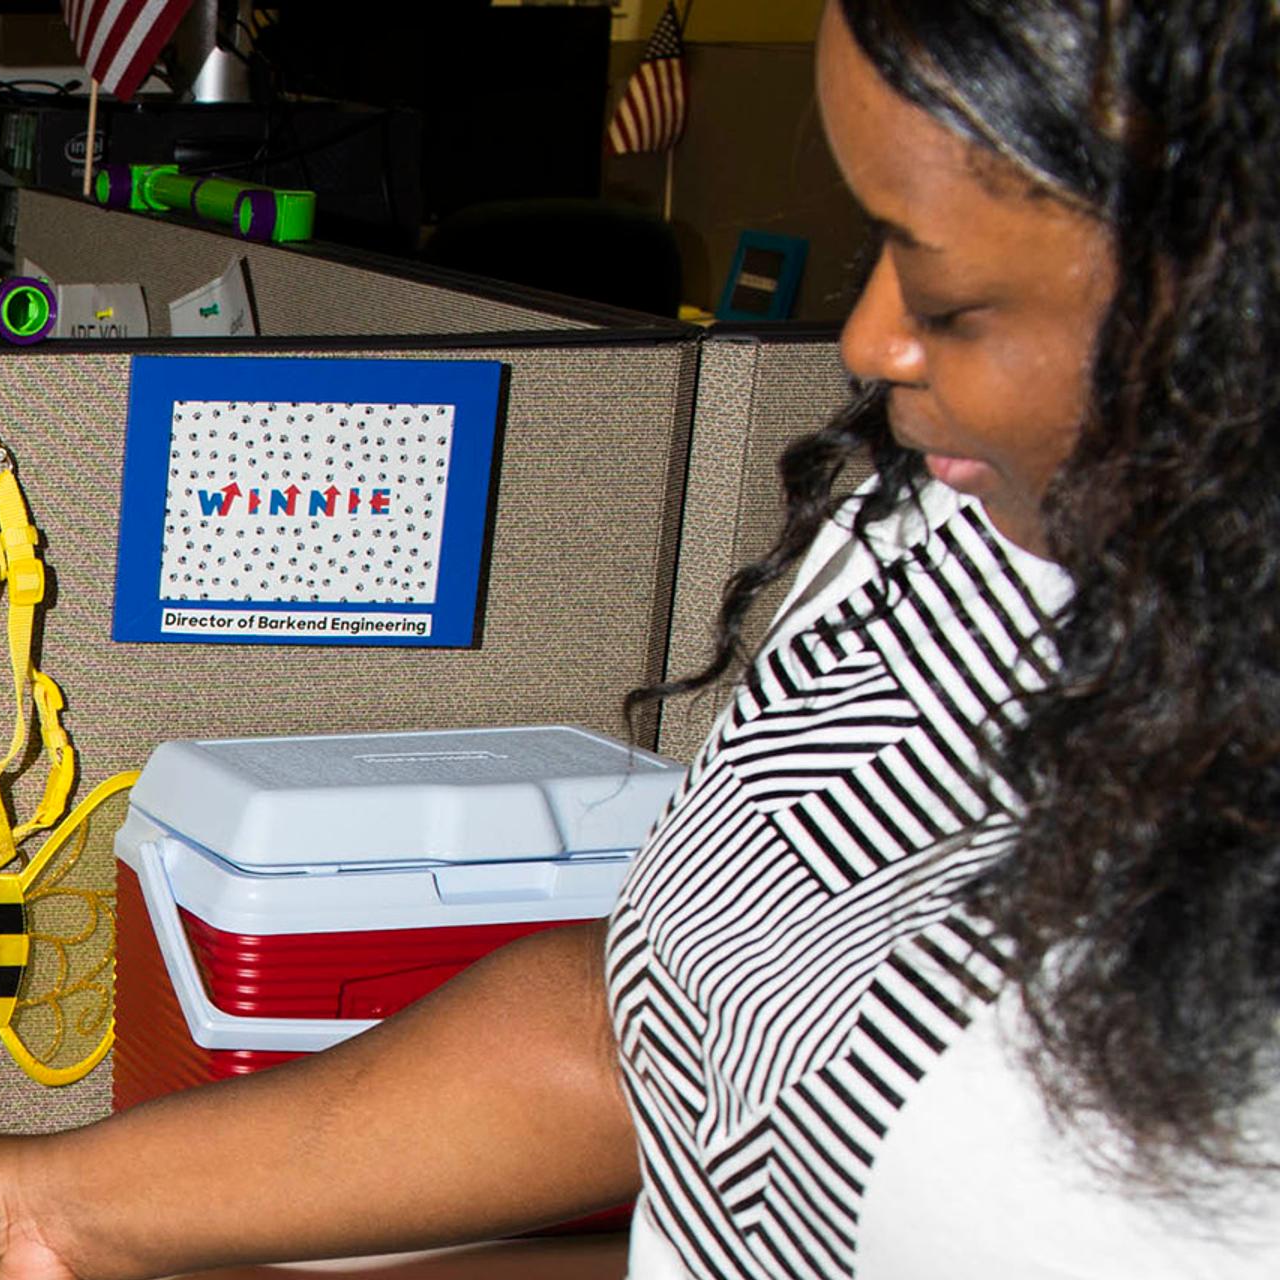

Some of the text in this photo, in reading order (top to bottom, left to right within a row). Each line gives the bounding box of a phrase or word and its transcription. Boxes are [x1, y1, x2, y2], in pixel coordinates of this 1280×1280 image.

[197, 482, 391, 517] WINNIE
[164, 612, 427, 635] Director of Barkend Engineering
